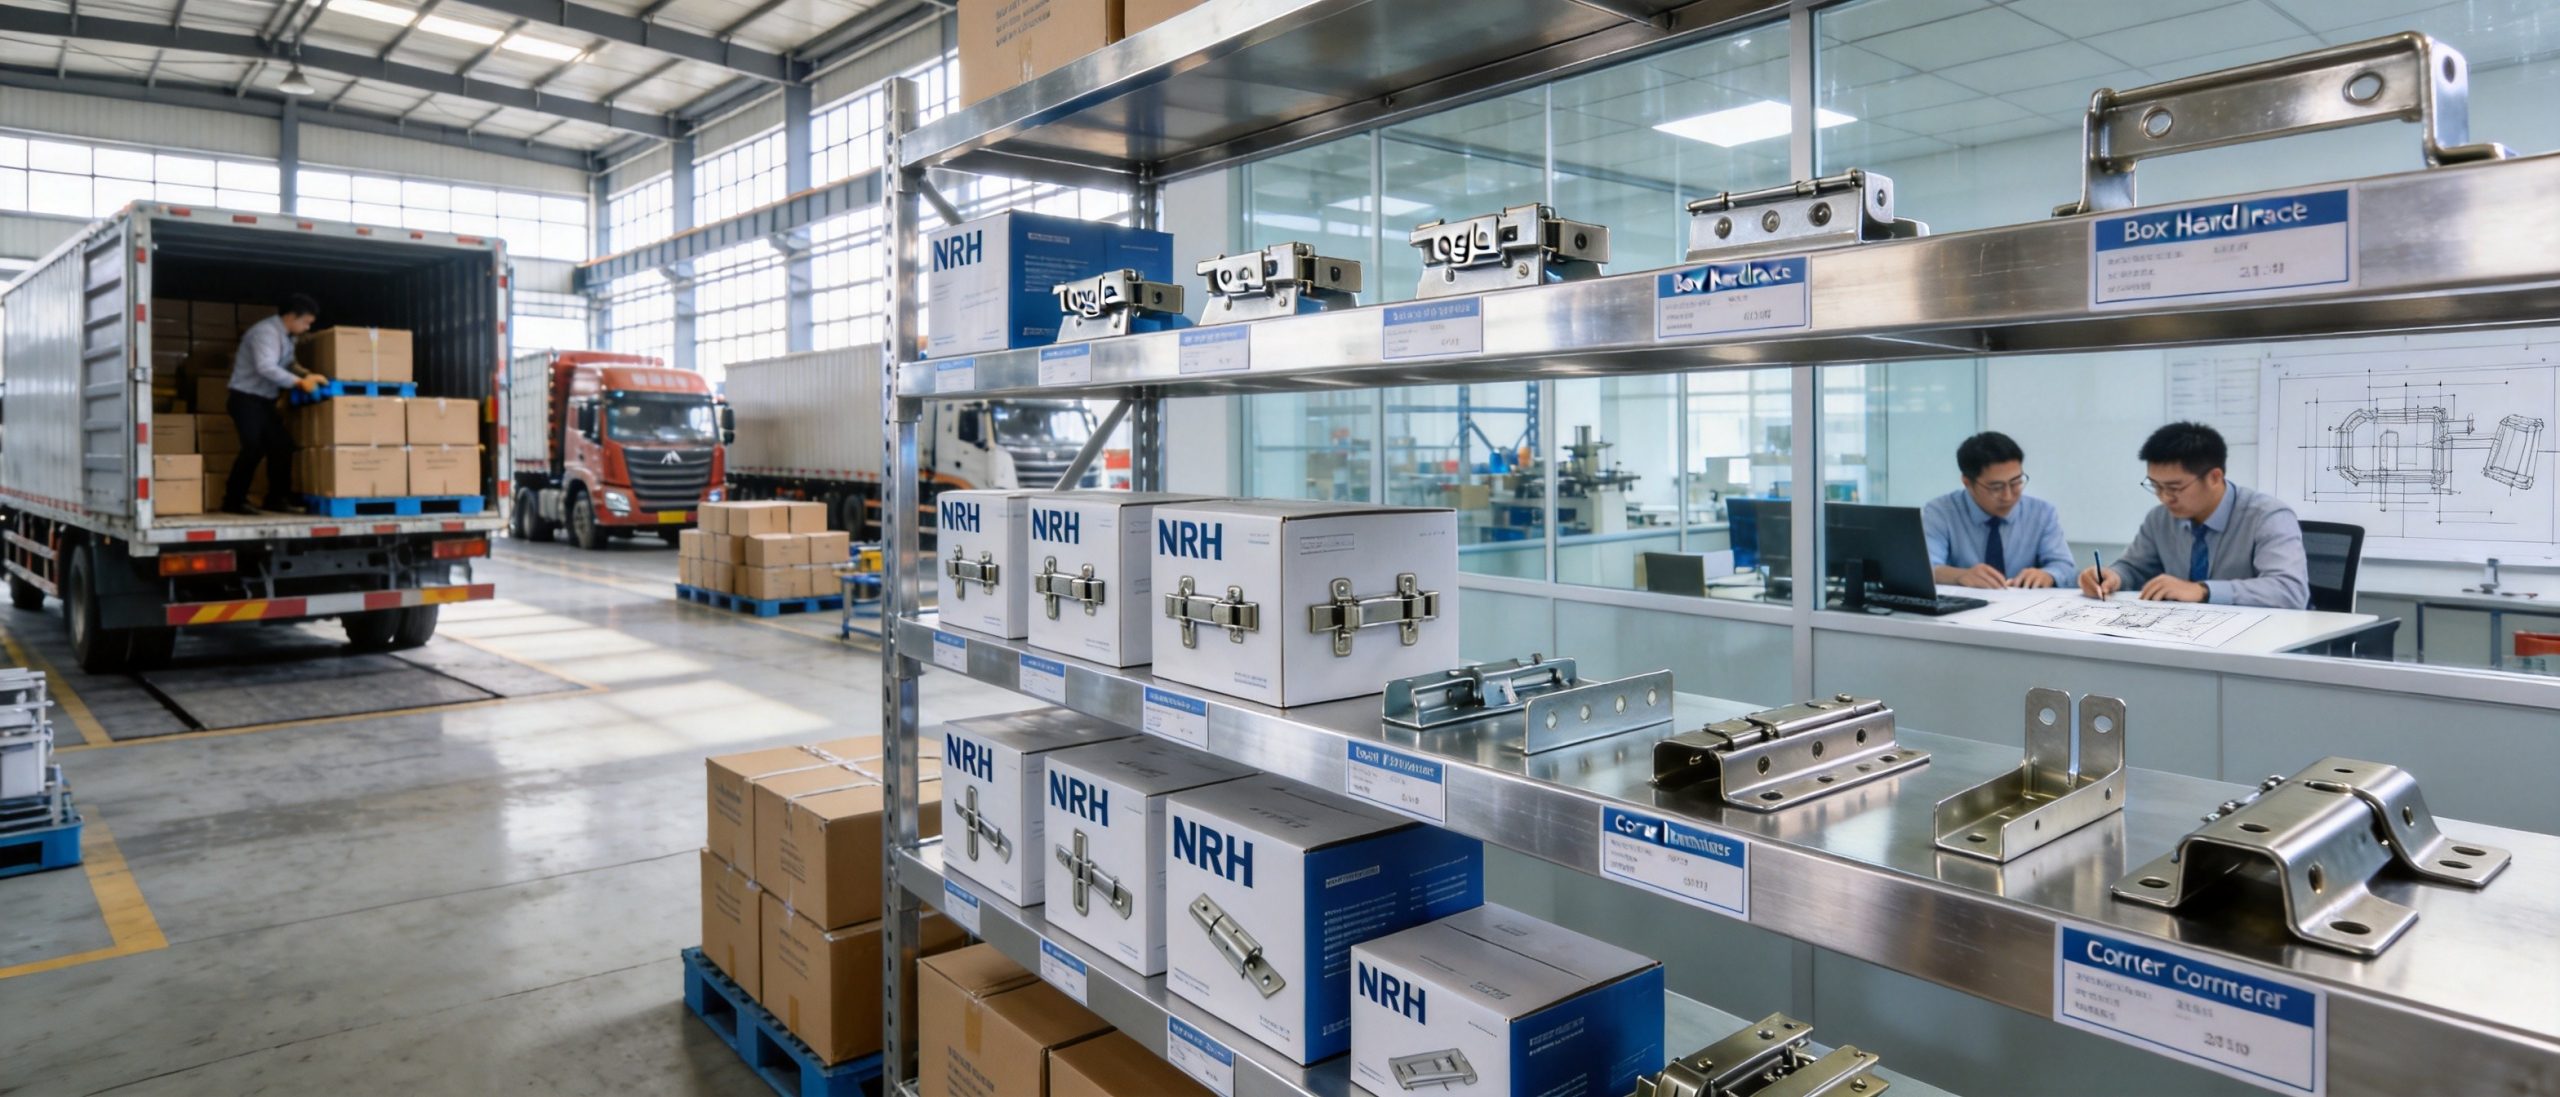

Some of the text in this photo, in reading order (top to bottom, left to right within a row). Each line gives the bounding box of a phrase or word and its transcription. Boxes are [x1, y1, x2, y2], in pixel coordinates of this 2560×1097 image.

[933, 229, 983, 273] NRH
[2124, 220, 2169, 243] Box
[941, 502, 980, 532] NRH
[1032, 510, 1080, 544] NRH
[1158, 519, 1223, 561] NRH
[946, 735, 993, 783] NRH
[1050, 772, 1109, 827] NRH
[1173, 816, 1254, 887] NRH
[1358, 964, 1426, 1024] NRH
